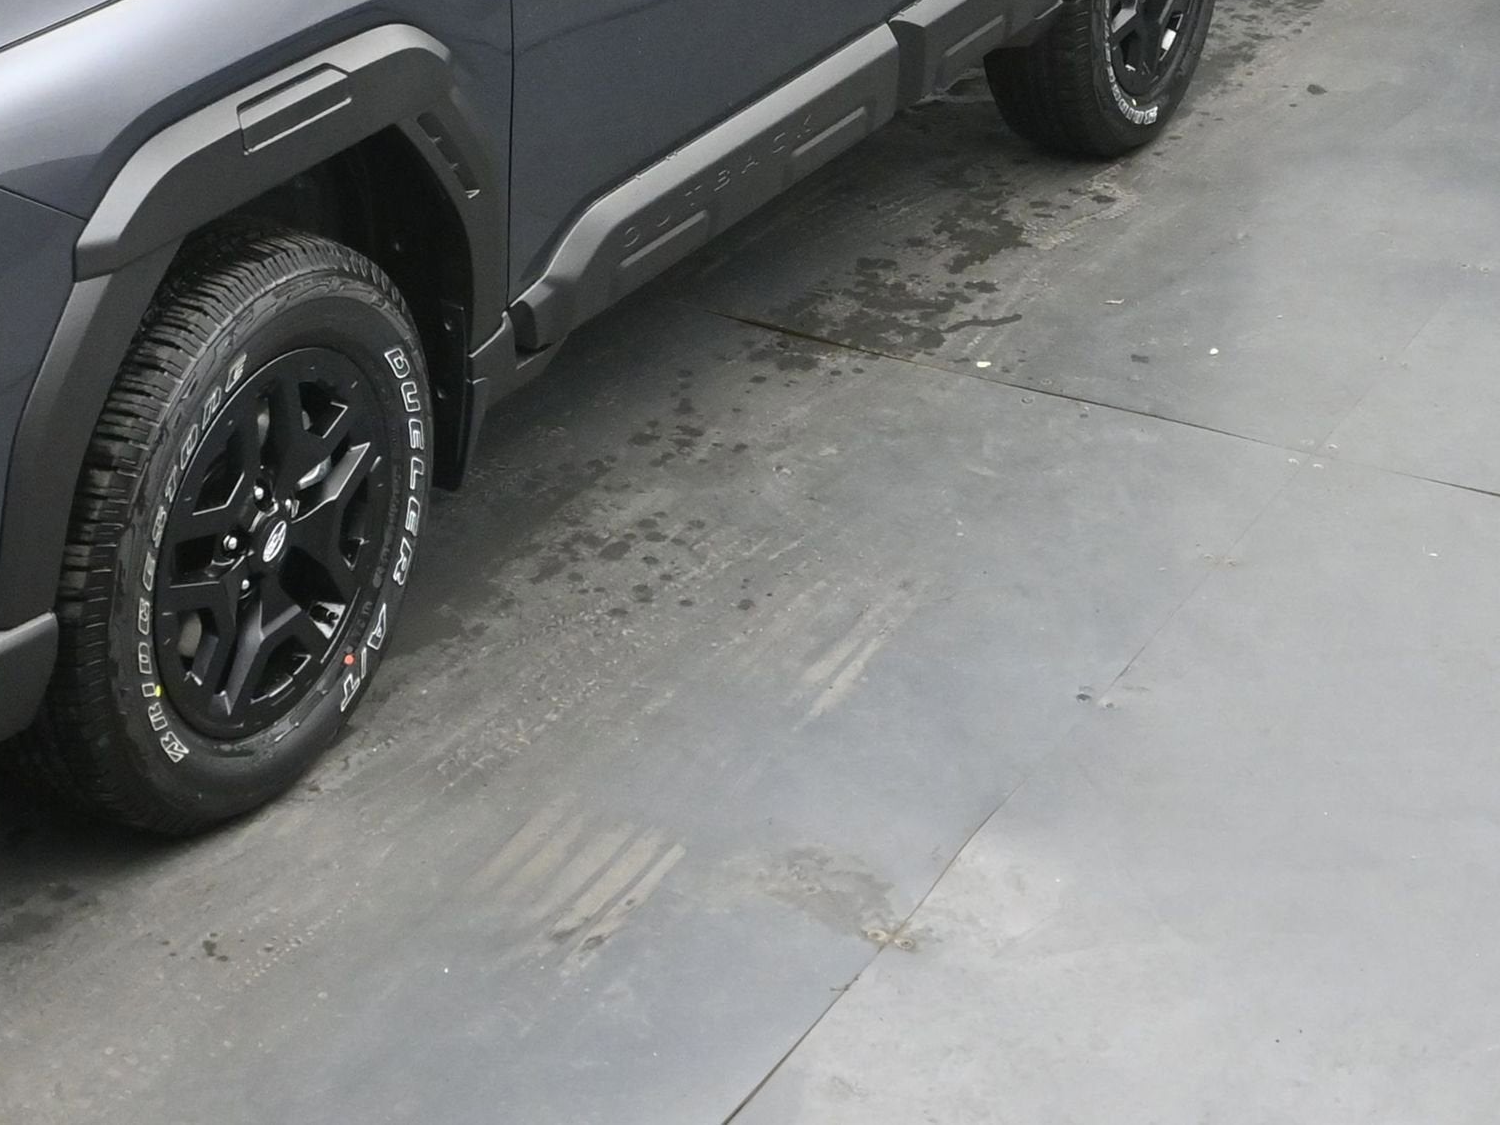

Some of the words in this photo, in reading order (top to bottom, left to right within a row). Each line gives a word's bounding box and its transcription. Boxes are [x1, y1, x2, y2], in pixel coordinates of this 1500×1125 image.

[137, 353, 247, 764] BRIDGESTONE
[384, 347, 426, 587] DUELER
[340, 602, 388, 712] A/T
